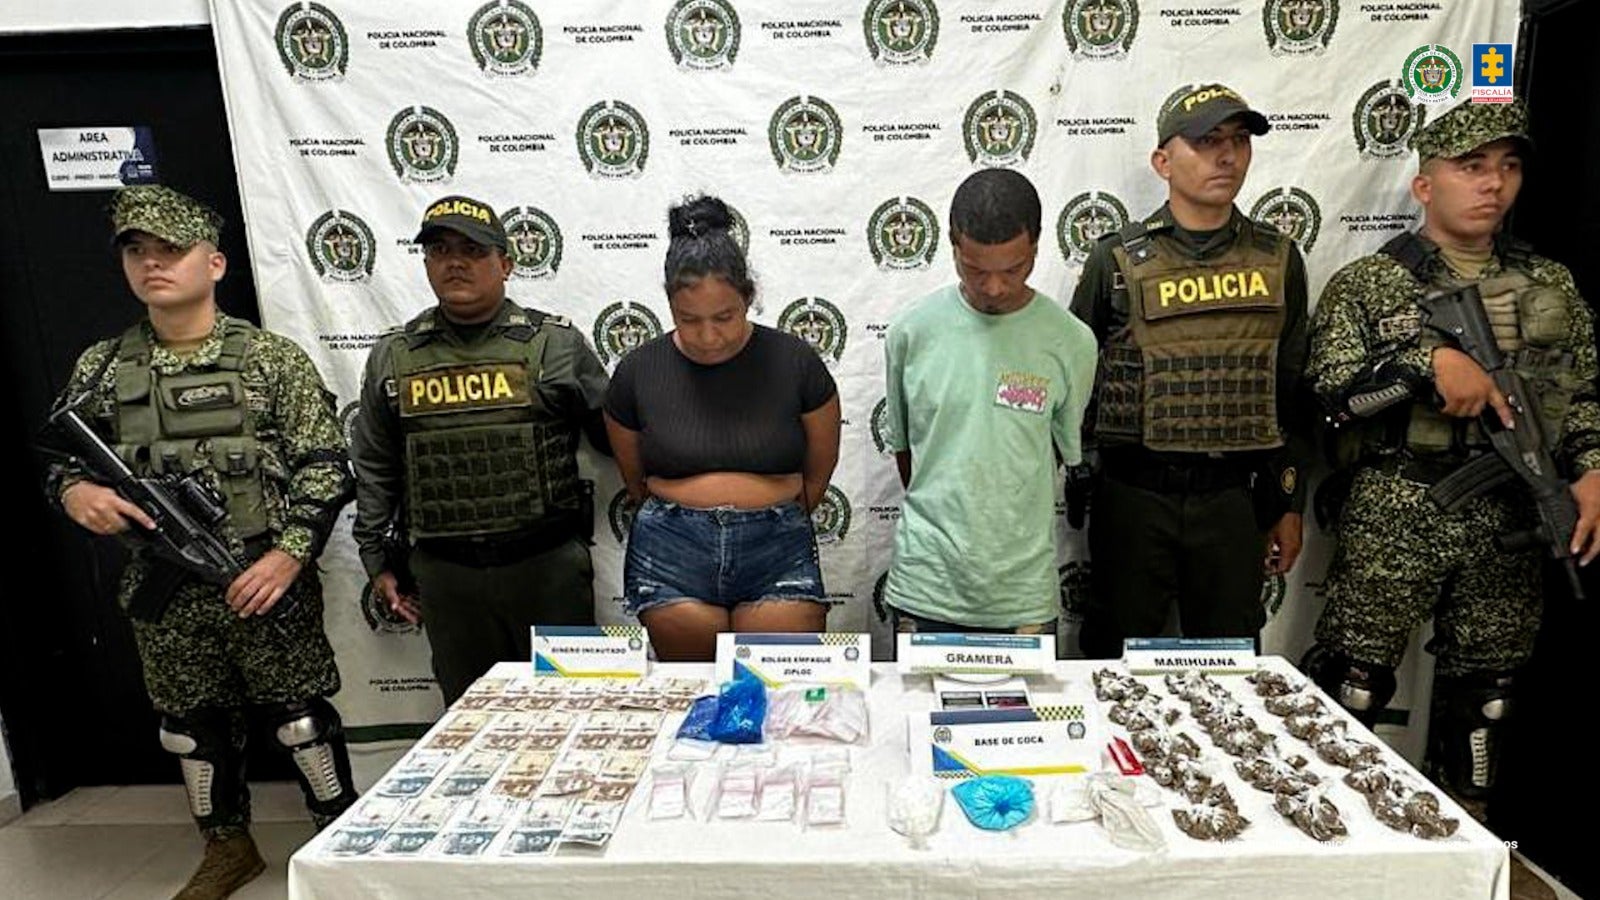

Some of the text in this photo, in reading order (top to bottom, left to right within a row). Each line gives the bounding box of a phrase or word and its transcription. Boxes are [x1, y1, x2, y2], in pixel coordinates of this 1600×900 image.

[1196, 8, 1241, 16] NACIONAL
[1360, 3, 1442, 12] POLICIA NACIONAL
[1384, 13, 1428, 21] COLOMBIA
[761, 19, 842, 29] POLICIA NACIONAL
[1184, 18, 1229, 26] COLOMBIA
[563, 24, 643, 33] POLICIA NACIONAL
[985, 23, 1029, 32] COLOMBIA
[367, 30, 446, 39] POLICIA NACIONAL
[588, 34, 634, 43] COLOMBIA
[773, 30, 831, 39] DE COLOMBIA
[380, 40, 437, 49] DE COLOMBIA
[1057, 117, 1135, 126] POLICIA NACIONAL
[862, 124, 895, 132] POLICIA
[1080, 127, 1125, 135] COLOMBIA
[1275, 123, 1320, 131] COLOMBIA
[512, 133, 556, 141] NACIONAL
[669, 128, 747, 137] POLICIA NACIONAL
[886, 133, 930, 141] COLOMBIA
[80, 132, 109, 143] AREA
[290, 138, 320, 146] POLICIA
[693, 137, 737, 145] COLOMBIA
[490, 144, 545, 152] DE COLOMBIA
[52, 147, 145, 161] ADMINISTRATIVA
[426, 200, 491, 225] POLICIA
[1348, 223, 1406, 232] DE COLOMBIA
[593, 242, 649, 250] DE COLOMBIA
[1159, 271, 1270, 307] POLICIA
[410, 372, 514, 406] POLICIA
[946, 653, 1013, 664] GRAMERA
[1154, 657, 1237, 666] MARIHUANA
[974, 738, 999, 746] BASE
[1017, 736, 1044, 744] COCA
